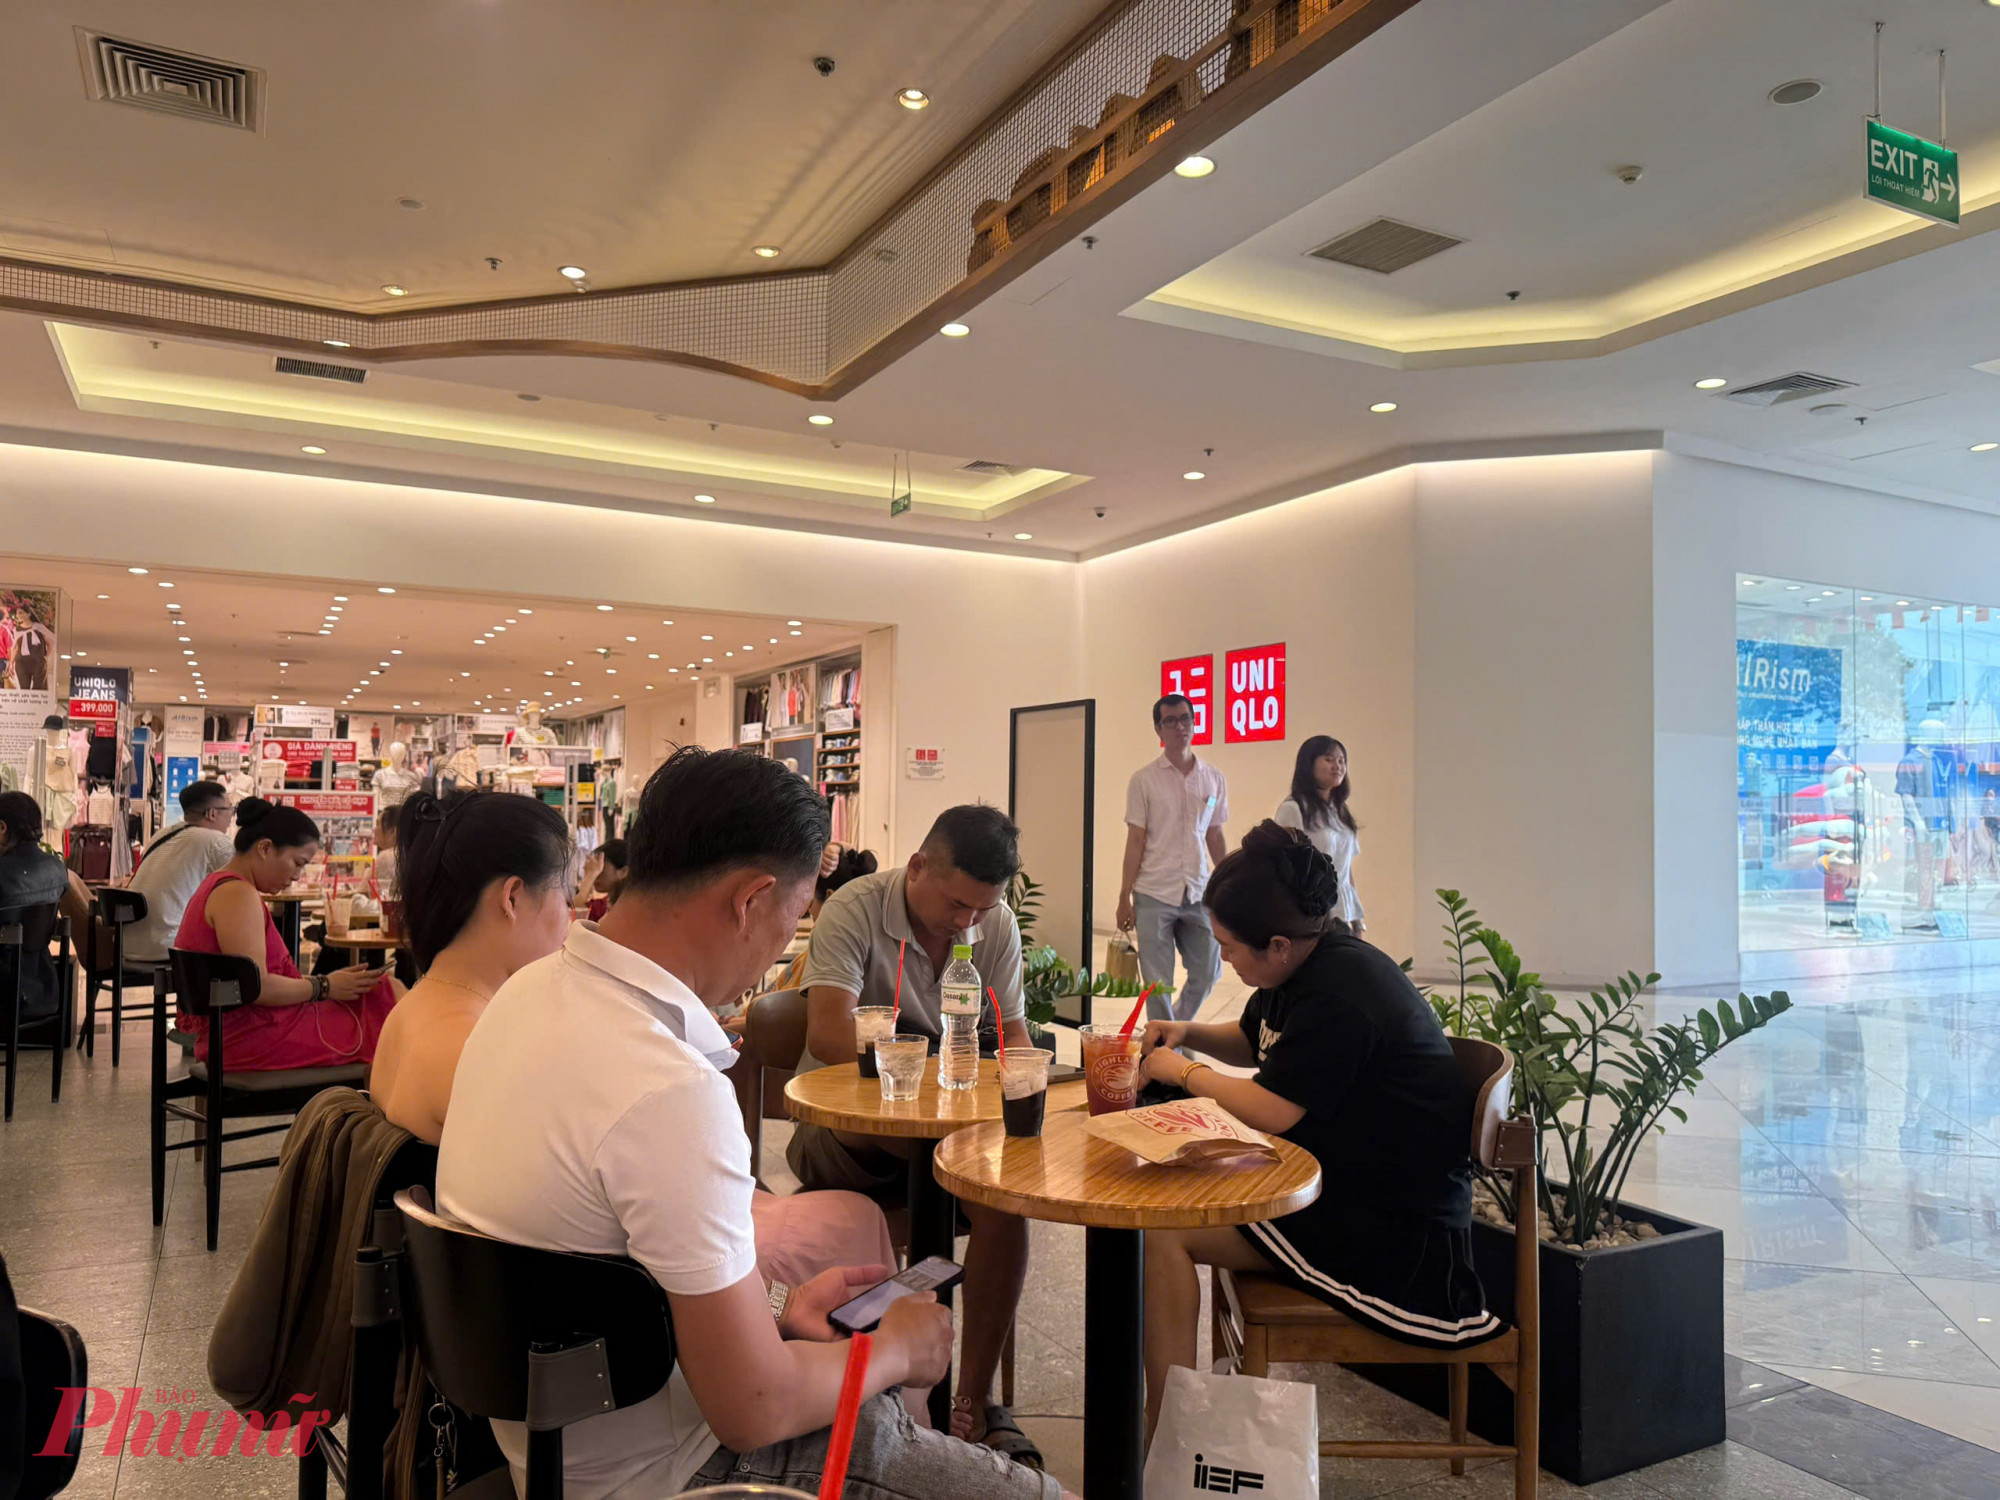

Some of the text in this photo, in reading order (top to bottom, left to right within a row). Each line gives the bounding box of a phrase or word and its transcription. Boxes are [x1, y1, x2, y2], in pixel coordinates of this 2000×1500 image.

[1870, 138, 1918, 180] EXIT
[74, 677, 116, 689] UNIQLO
[1232, 657, 1275, 693] UNI
[74, 688, 116, 700] JEANS
[81, 702, 113, 713] 399.000
[1232, 696, 1279, 736] QLO
[1094, 1055, 1138, 1074] HIGHLA
